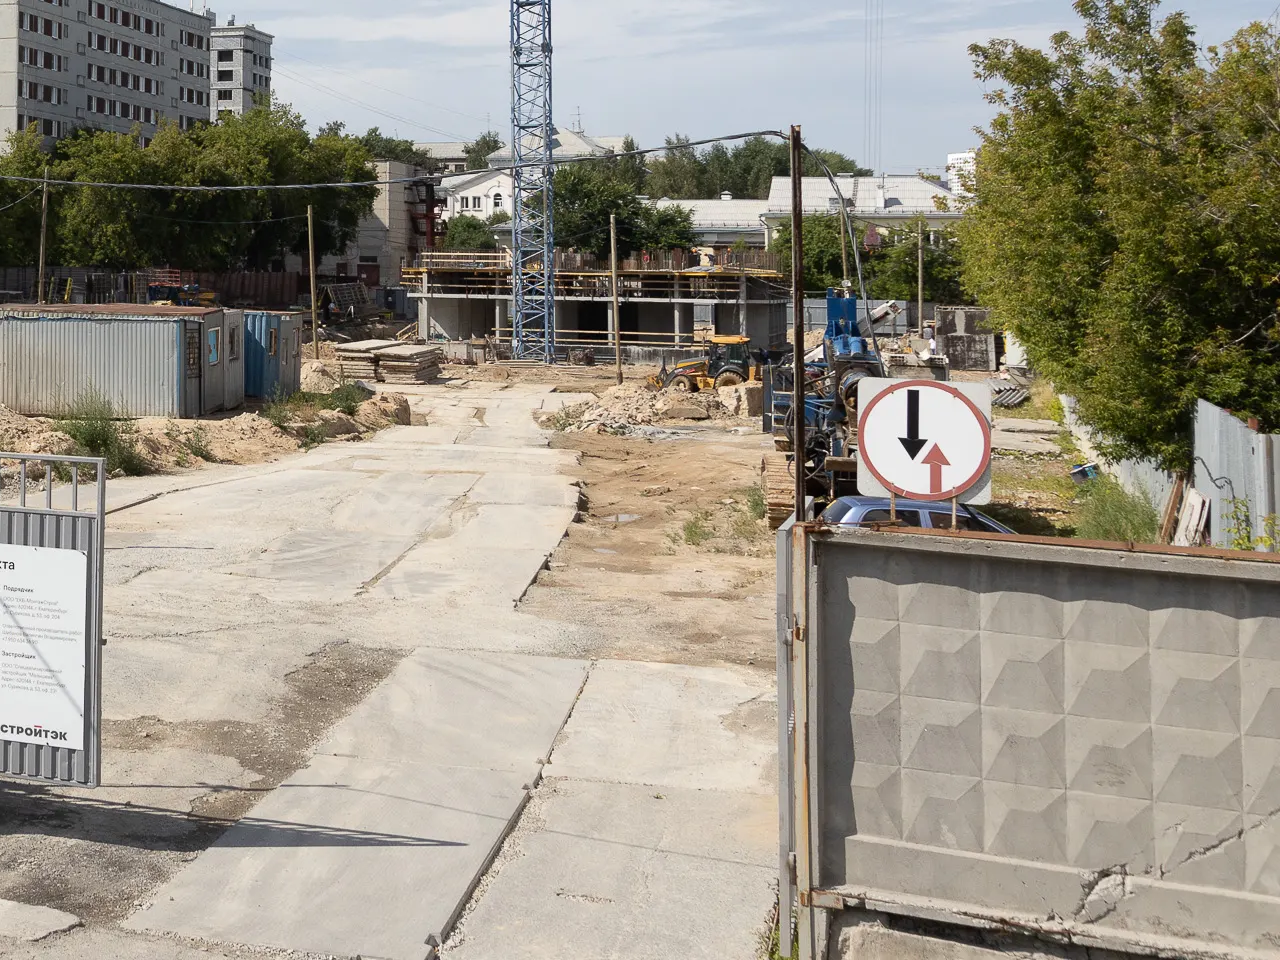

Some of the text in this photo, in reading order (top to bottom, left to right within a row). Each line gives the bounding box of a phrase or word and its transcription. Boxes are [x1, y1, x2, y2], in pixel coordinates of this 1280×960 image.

[3, 584, 33, 593] Подрядчик
[1, 650, 36, 660] Застройщик
[0, 725, 68, 742] СТРОЙТЭК
